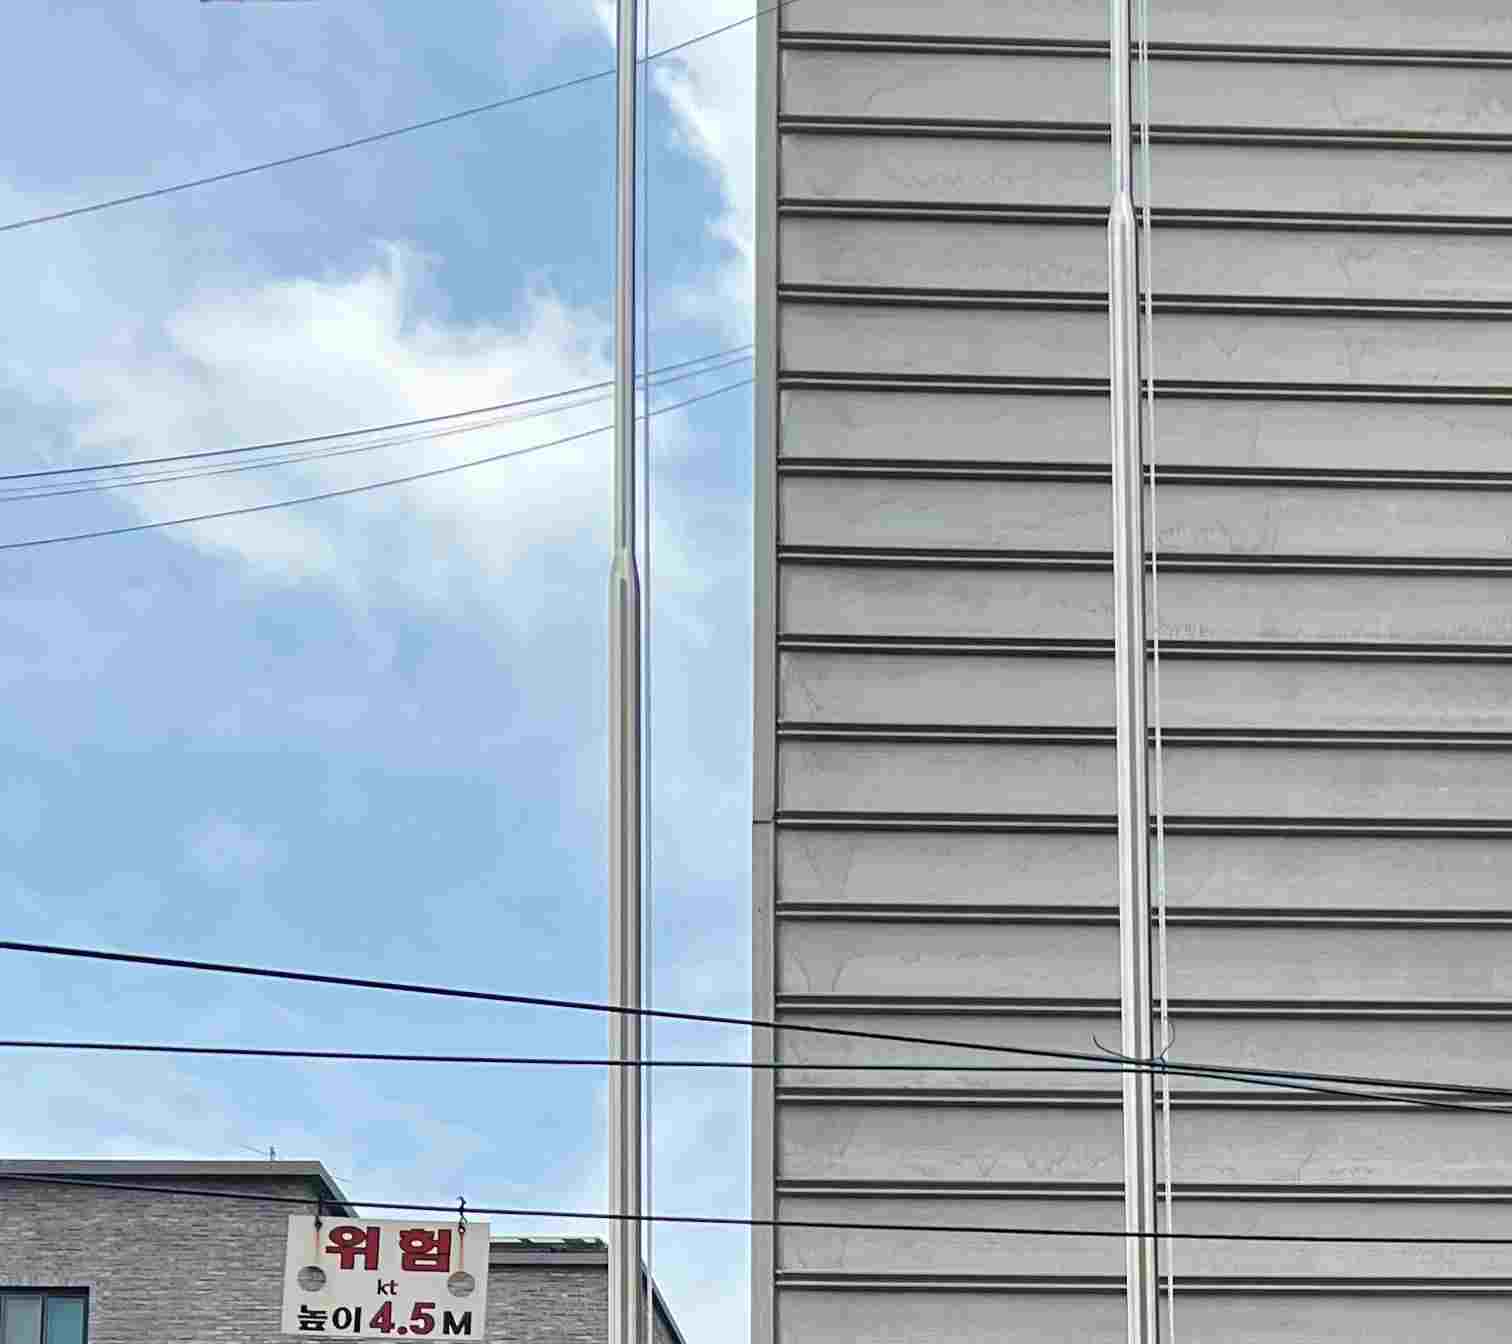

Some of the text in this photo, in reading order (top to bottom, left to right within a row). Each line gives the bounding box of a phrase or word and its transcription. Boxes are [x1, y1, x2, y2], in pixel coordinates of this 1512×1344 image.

[324, 1225, 452, 1273] 위험
[377, 1279, 399, 1296] kt
[297, 1304, 362, 1333] 높이
[369, 1300, 436, 1335] 4.5
